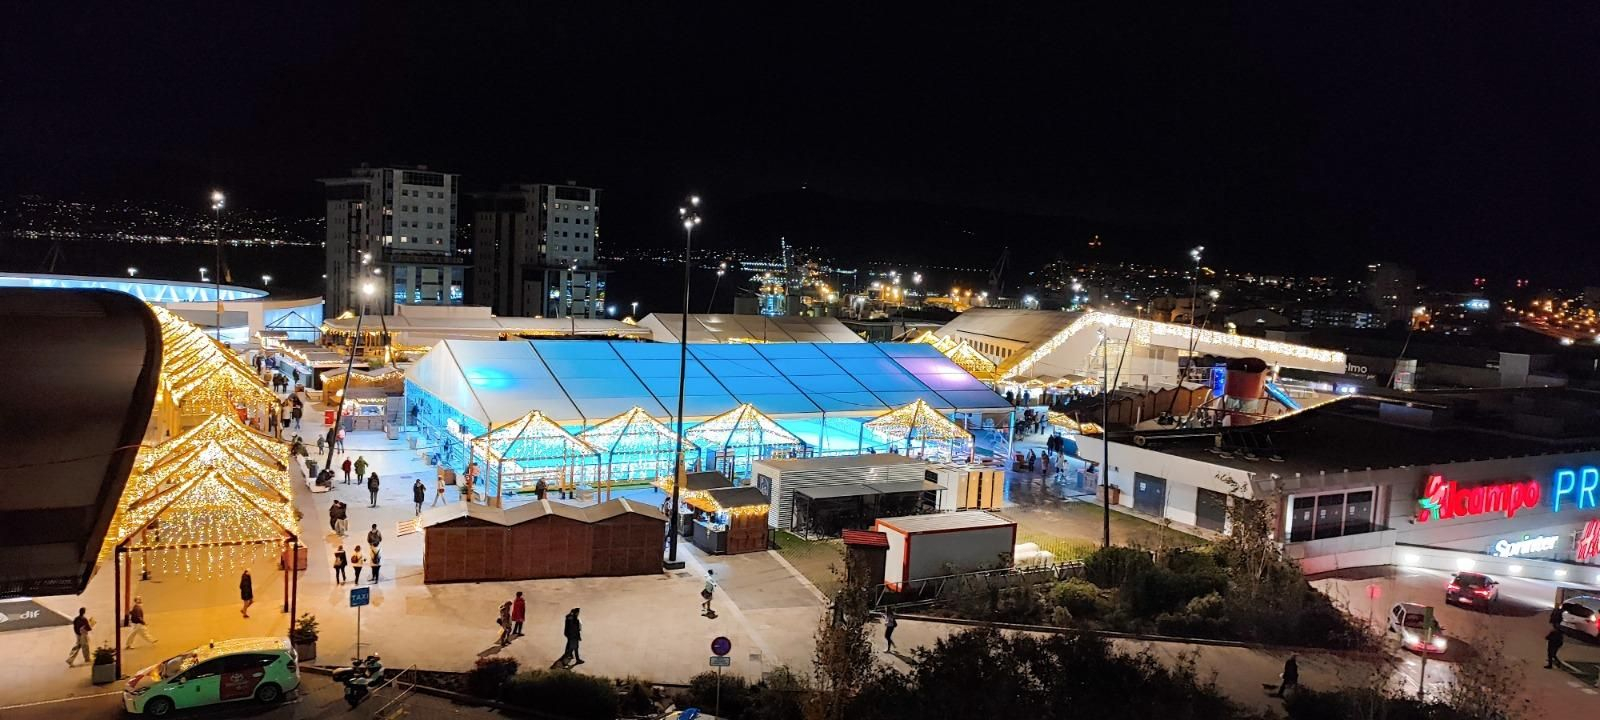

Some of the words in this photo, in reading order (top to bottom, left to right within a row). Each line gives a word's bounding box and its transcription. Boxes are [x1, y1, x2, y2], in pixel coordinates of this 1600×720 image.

[1417, 474, 1542, 522] Alcampo
[1493, 535, 1560, 557] Sprinter
[351, 592, 369, 602] TAXI
